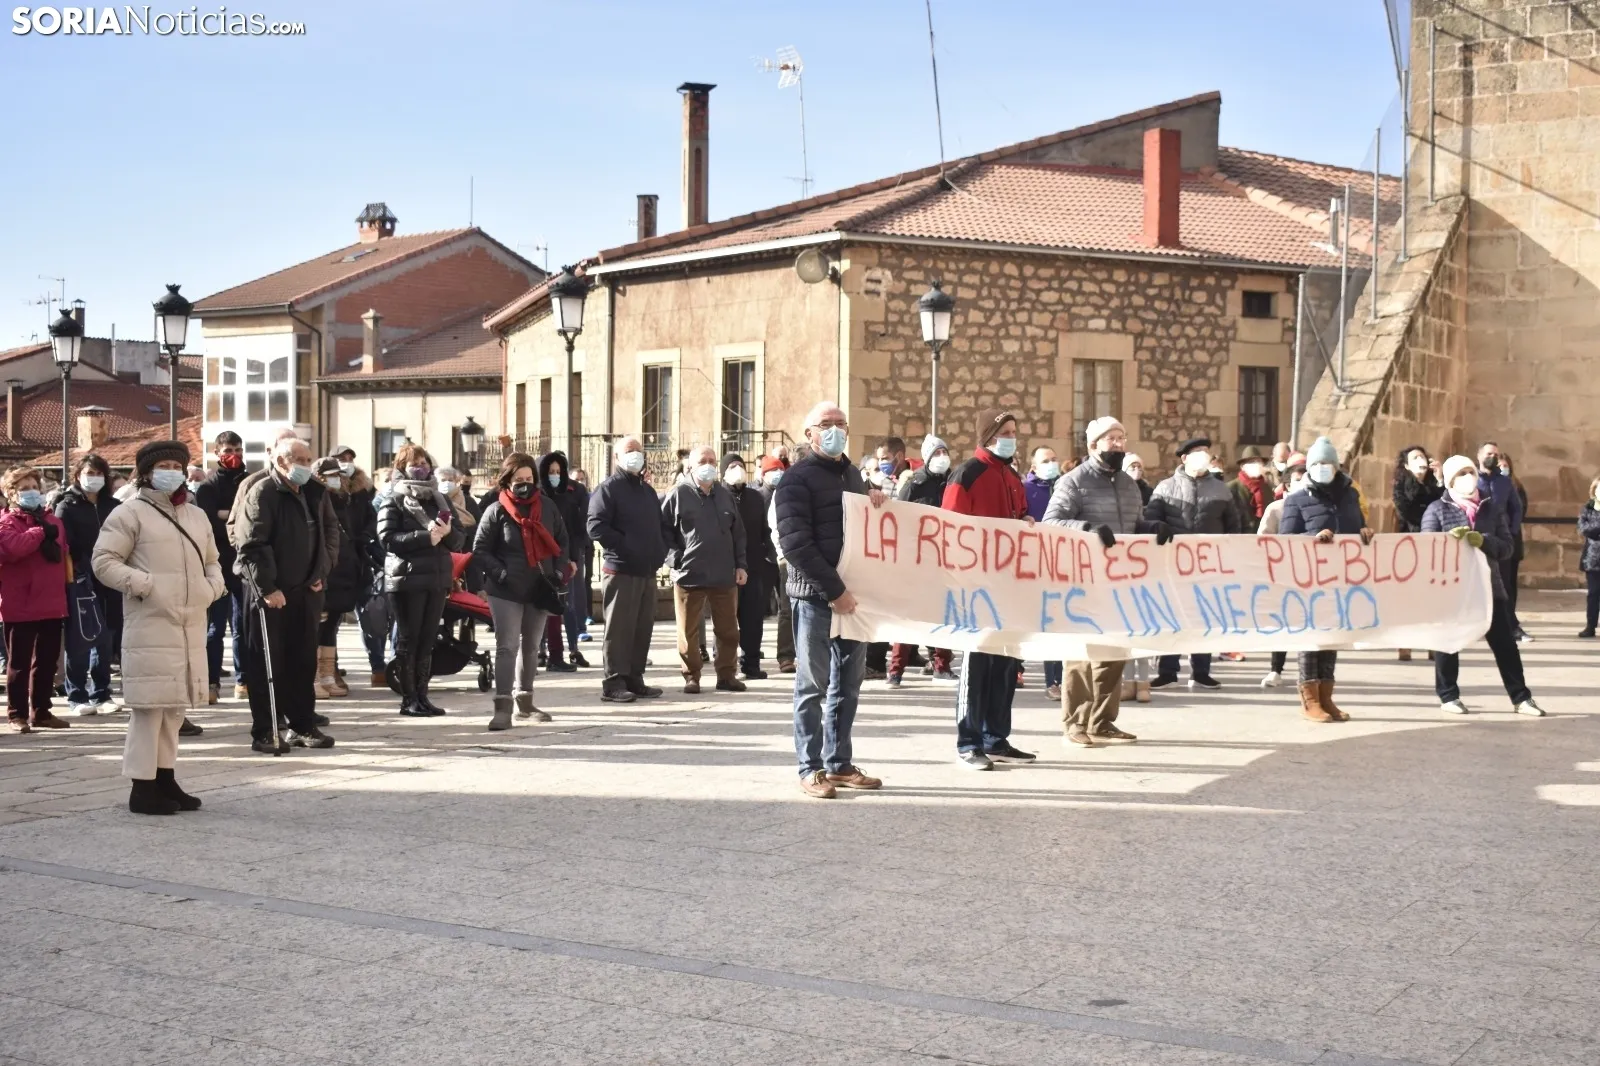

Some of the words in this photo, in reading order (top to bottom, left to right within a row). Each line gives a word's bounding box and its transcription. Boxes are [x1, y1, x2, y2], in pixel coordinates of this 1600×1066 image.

[864, 506, 898, 564] LA
[916, 514, 1094, 585] RESIDENCIA
[1103, 540, 1149, 580] ES
[930, 588, 1003, 634] NO
[1113, 581, 1181, 637] UN
[1192, 584, 1380, 636] NEGOCIO
